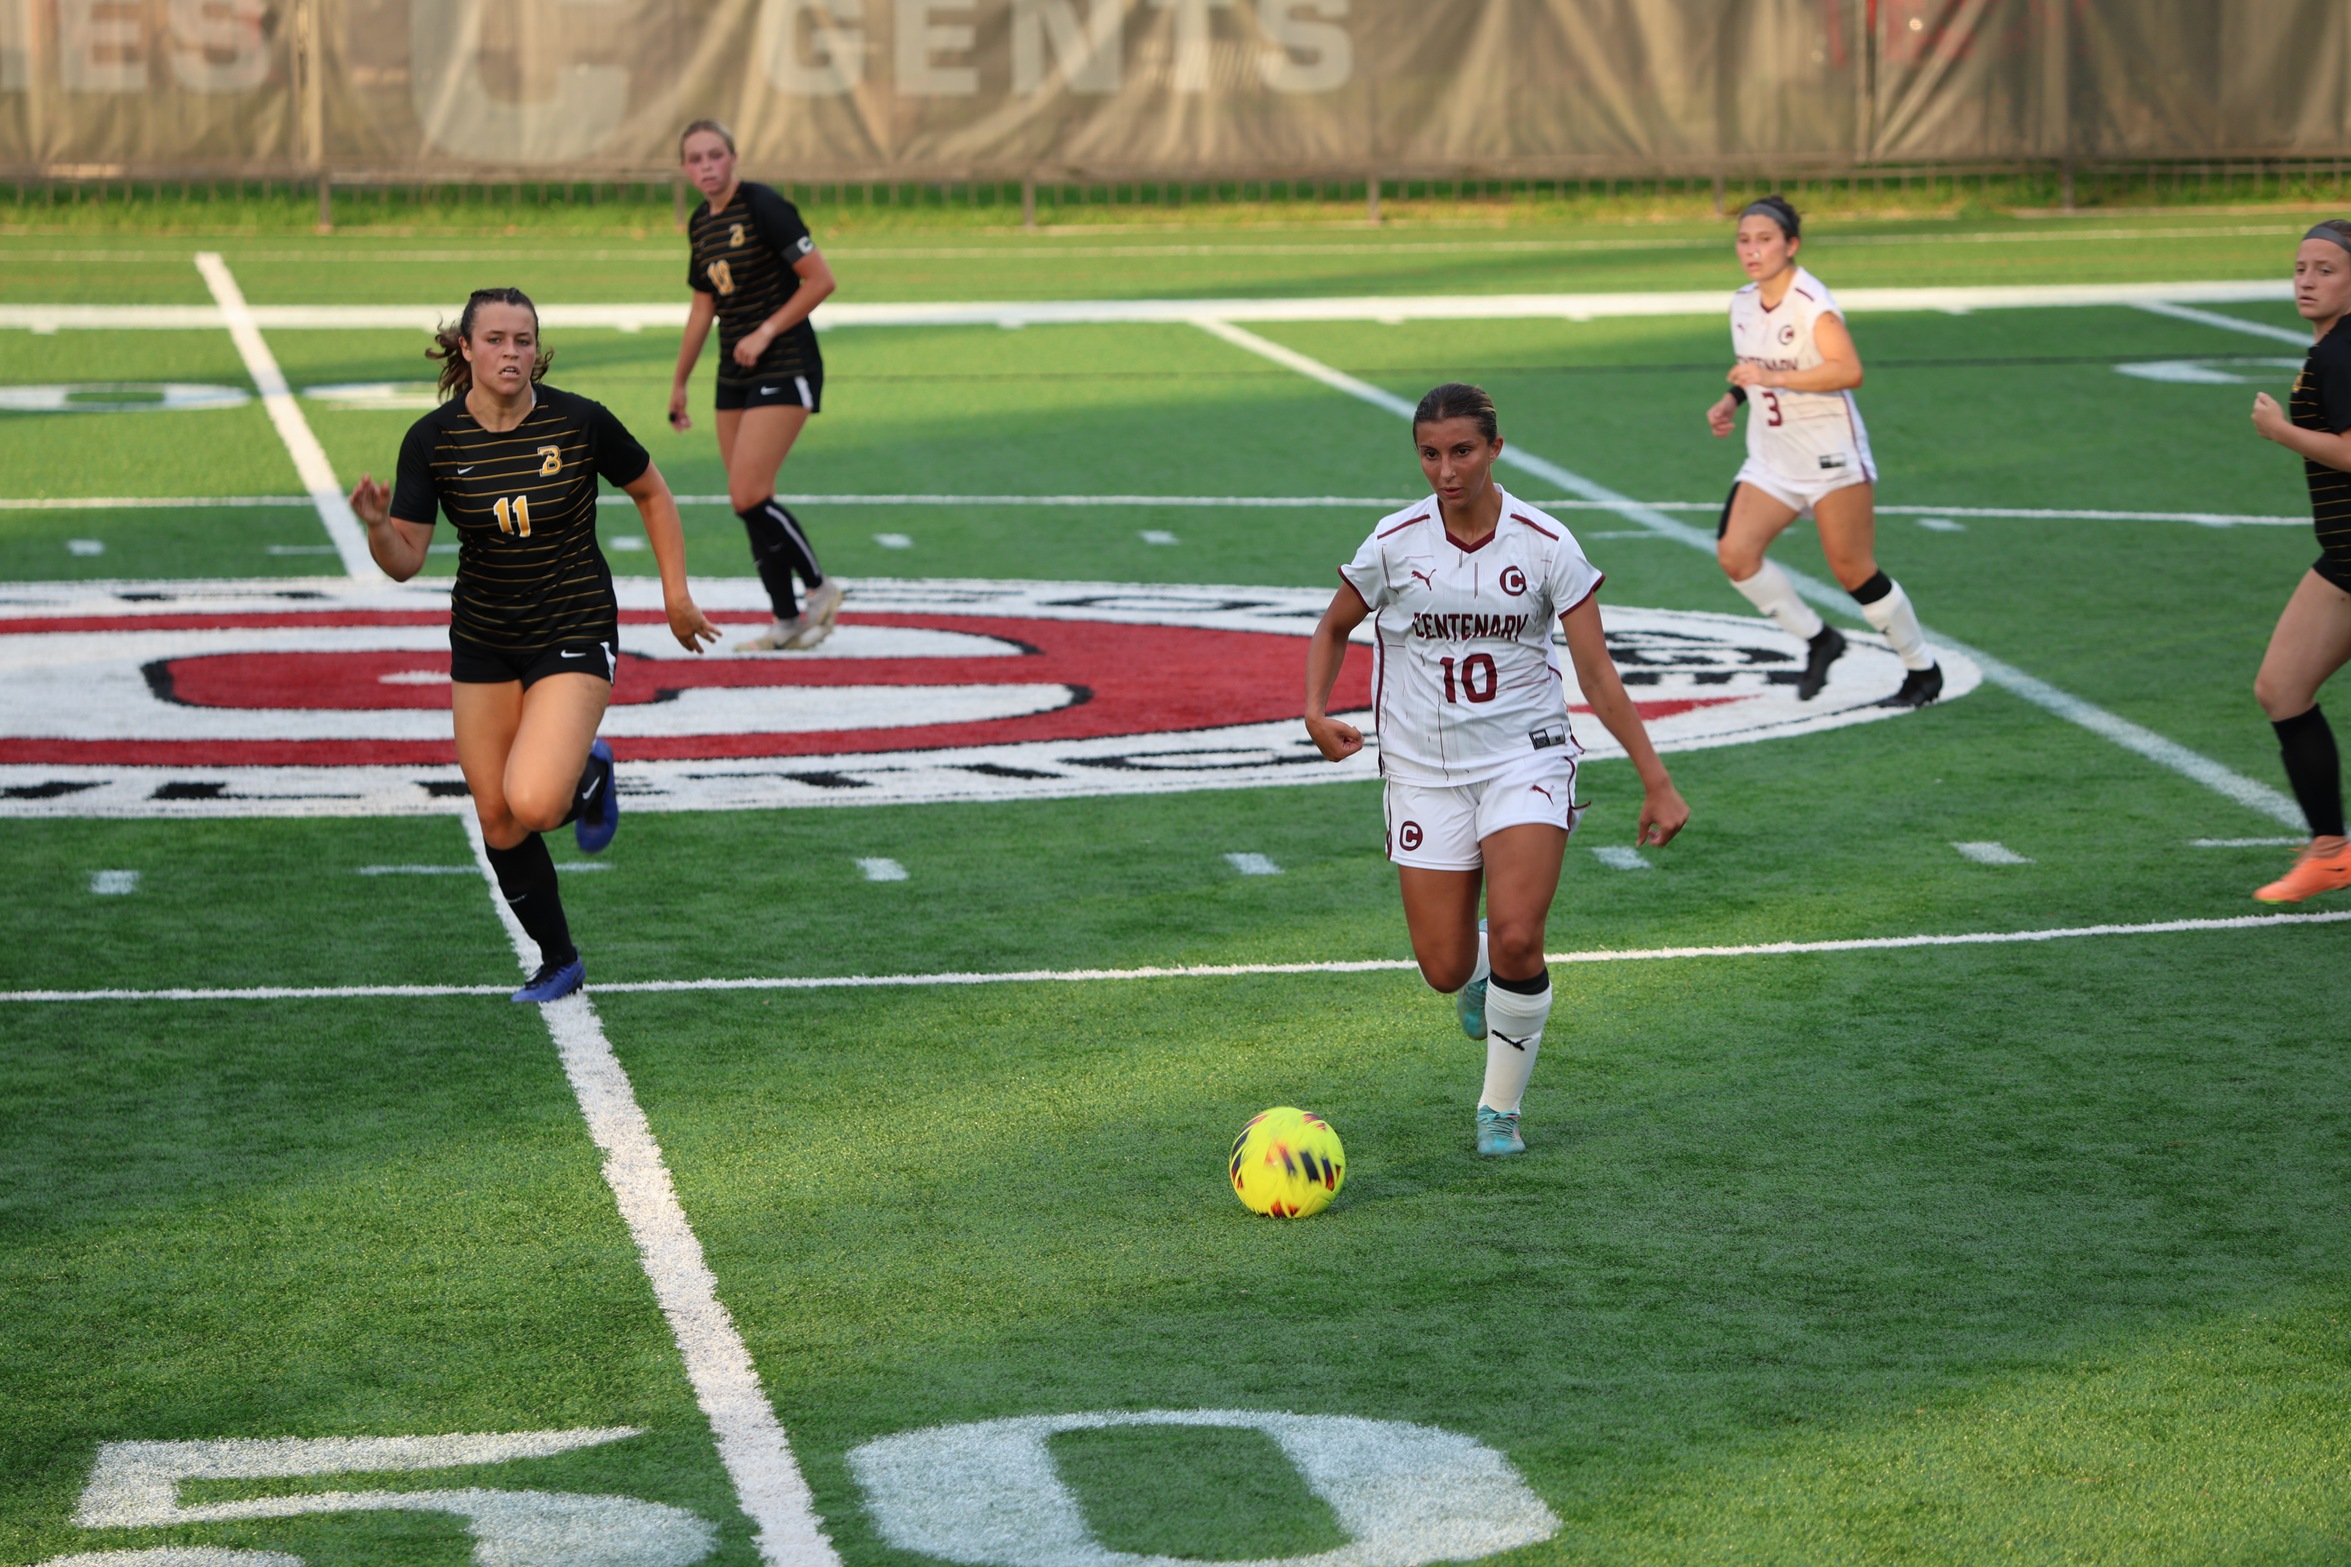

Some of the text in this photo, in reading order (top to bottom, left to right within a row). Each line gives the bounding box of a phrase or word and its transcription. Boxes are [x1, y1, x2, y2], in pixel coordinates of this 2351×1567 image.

[764, 0, 1354, 96] GENTS
[1761, 391, 1784, 427] 3
[537, 445, 563, 478] B
[493, 495, 532, 538] 11
[1499, 565, 1528, 597] C
[1412, 612, 1529, 643] CENTENARY
[1439, 653, 1498, 704] 10
[1399, 820, 1424, 852] C
